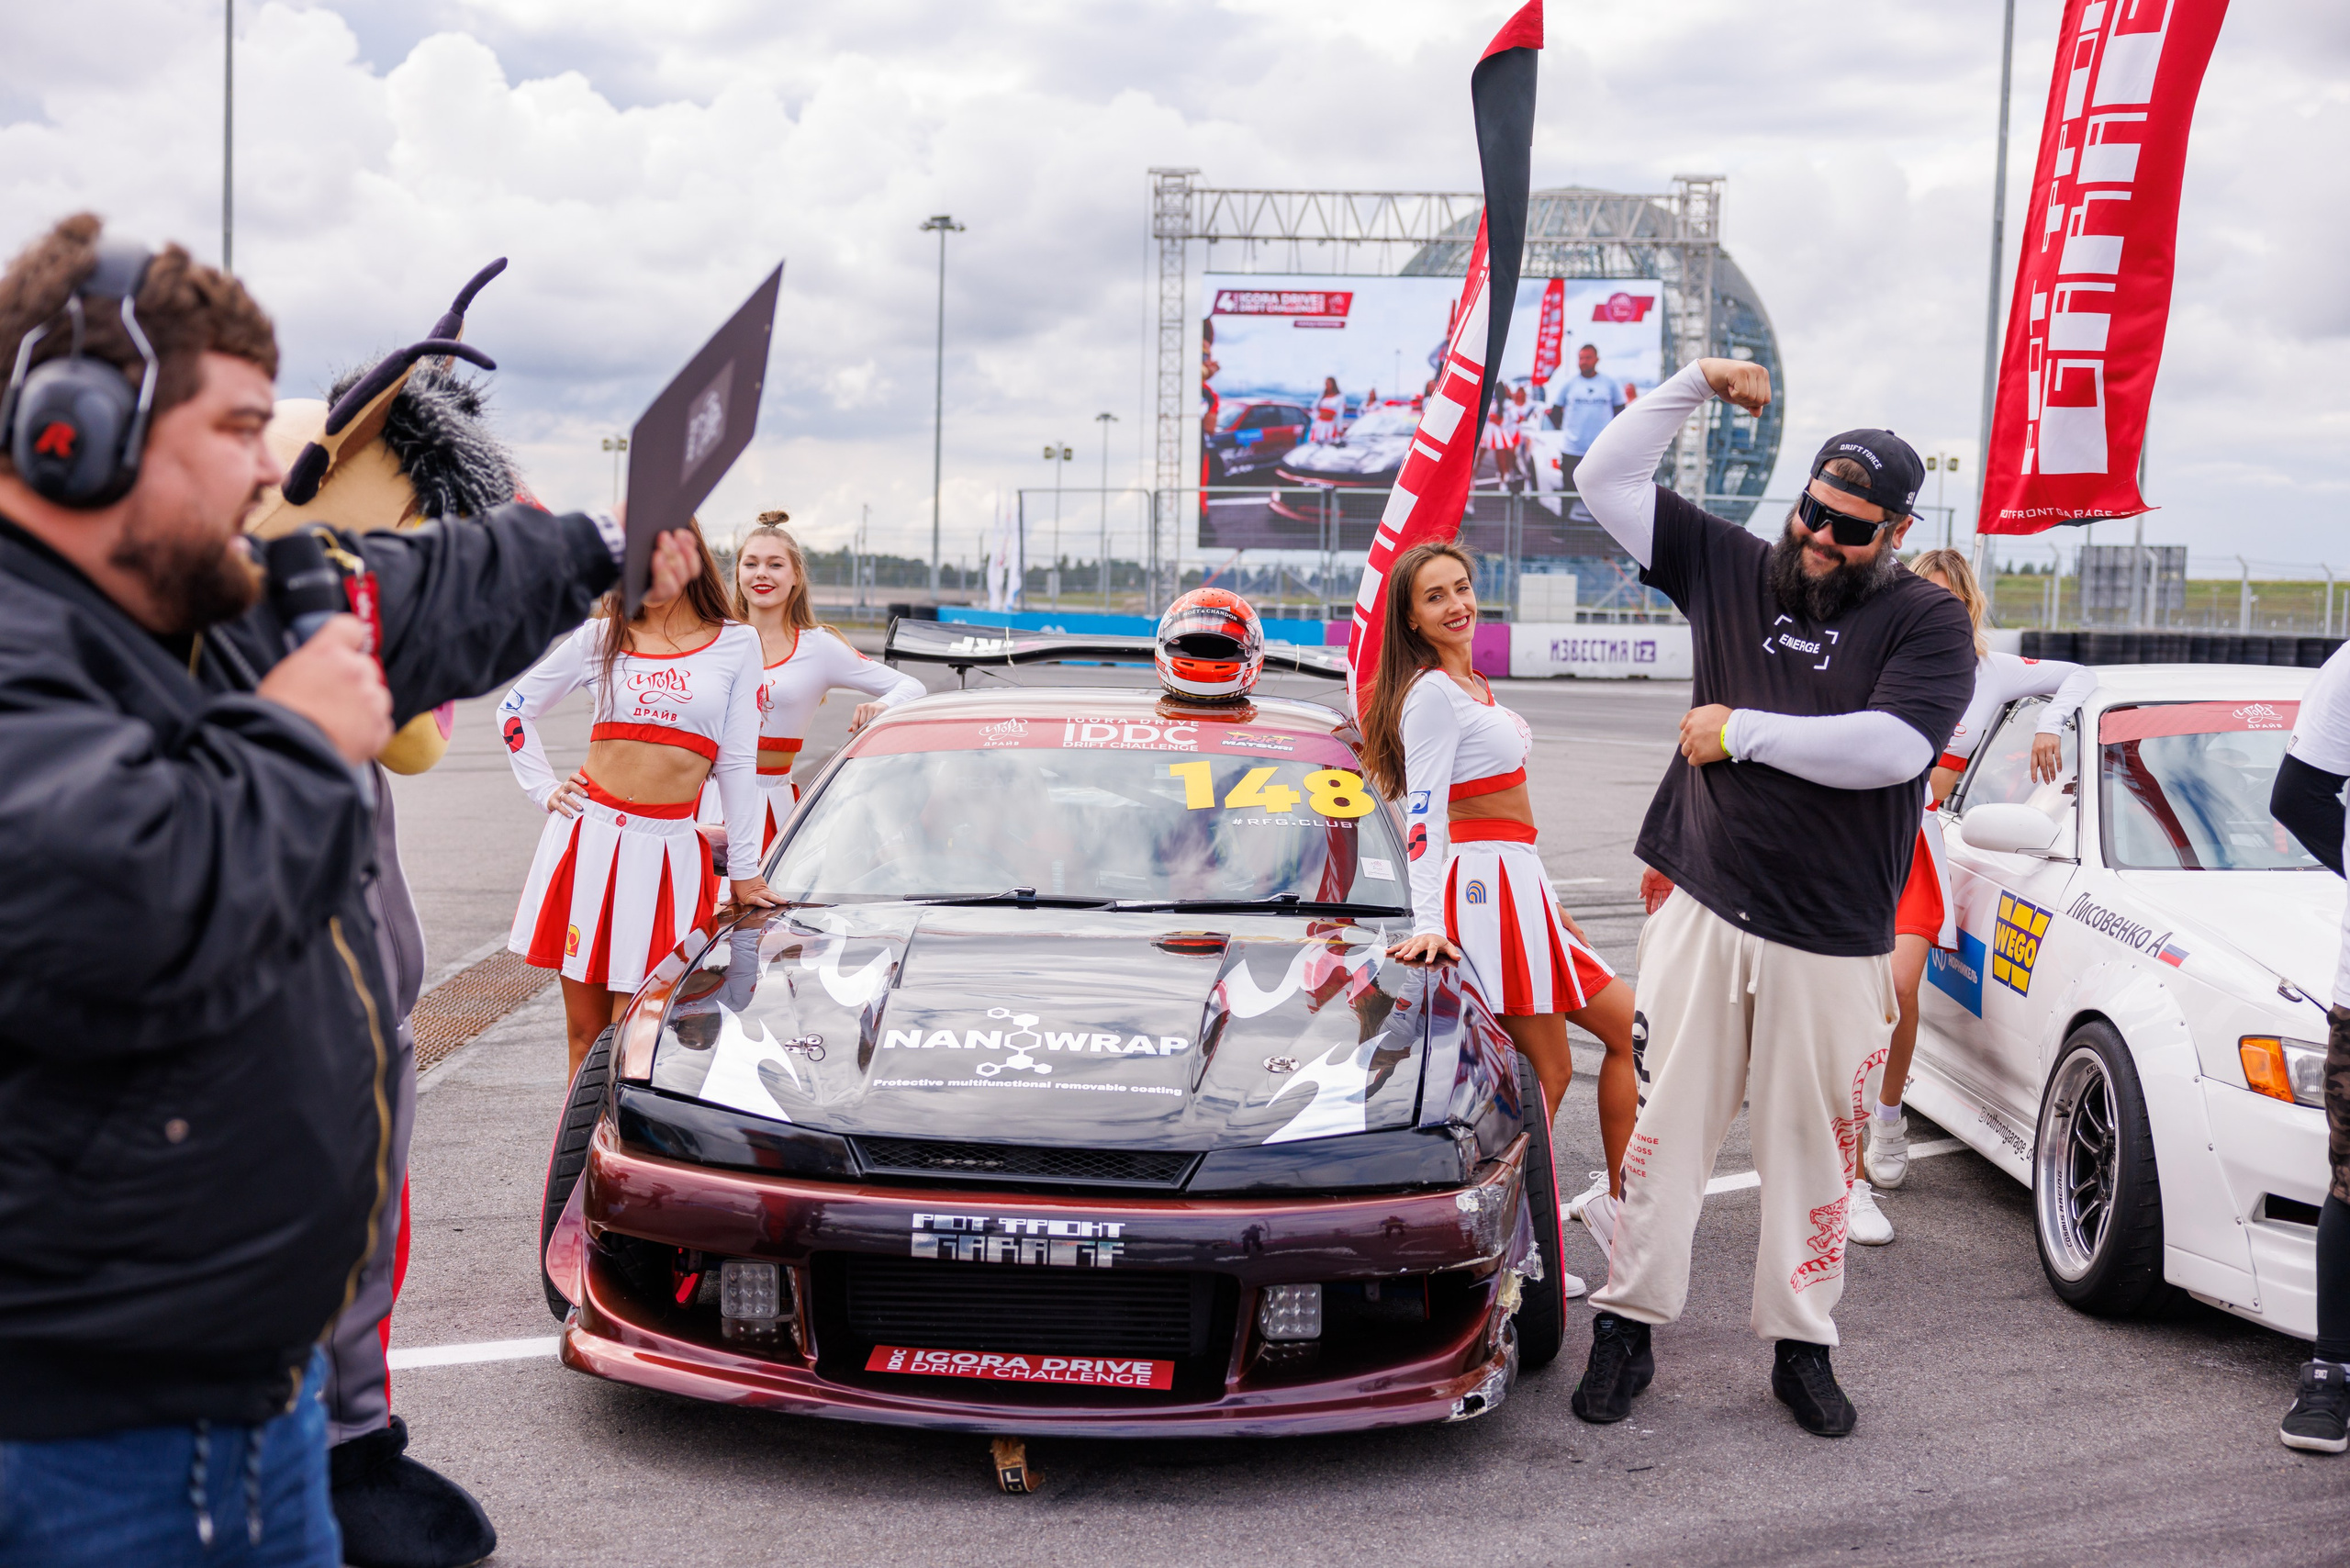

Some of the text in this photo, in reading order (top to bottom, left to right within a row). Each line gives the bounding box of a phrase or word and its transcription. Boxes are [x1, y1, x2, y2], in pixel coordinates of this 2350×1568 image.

[1840, 443, 1883, 470] DRIFT FORCE
[1205, 608, 1237, 622] CHANDON
[1550, 639, 1628, 662] ИЗВЕСТИЯ
[633, 707, 677, 722] ДРАЙВ
[1139, 719, 1200, 727] DRIVE
[1063, 723, 1199, 745] IDDC
[1062, 741, 1199, 752] DRIFT CHALLENGE
[1221, 740, 1294, 752] MATSURI
[1169, 760, 1376, 819] 148
[1232, 818, 1352, 829] #RFG.CLUB
[1994, 920, 2037, 969] WEGO
[873, 1078, 1183, 1097] Protective multifunctional removable coating
[1633, 1145, 1652, 1156] LOSS
[2057, 1170, 2073, 1248] COSMIS RACING
[887, 1349, 908, 1371] IDDC
[913, 1350, 1154, 1375] IGORA DRIVE
[910, 1361, 1152, 1386] DRIFT CHALLENGE
